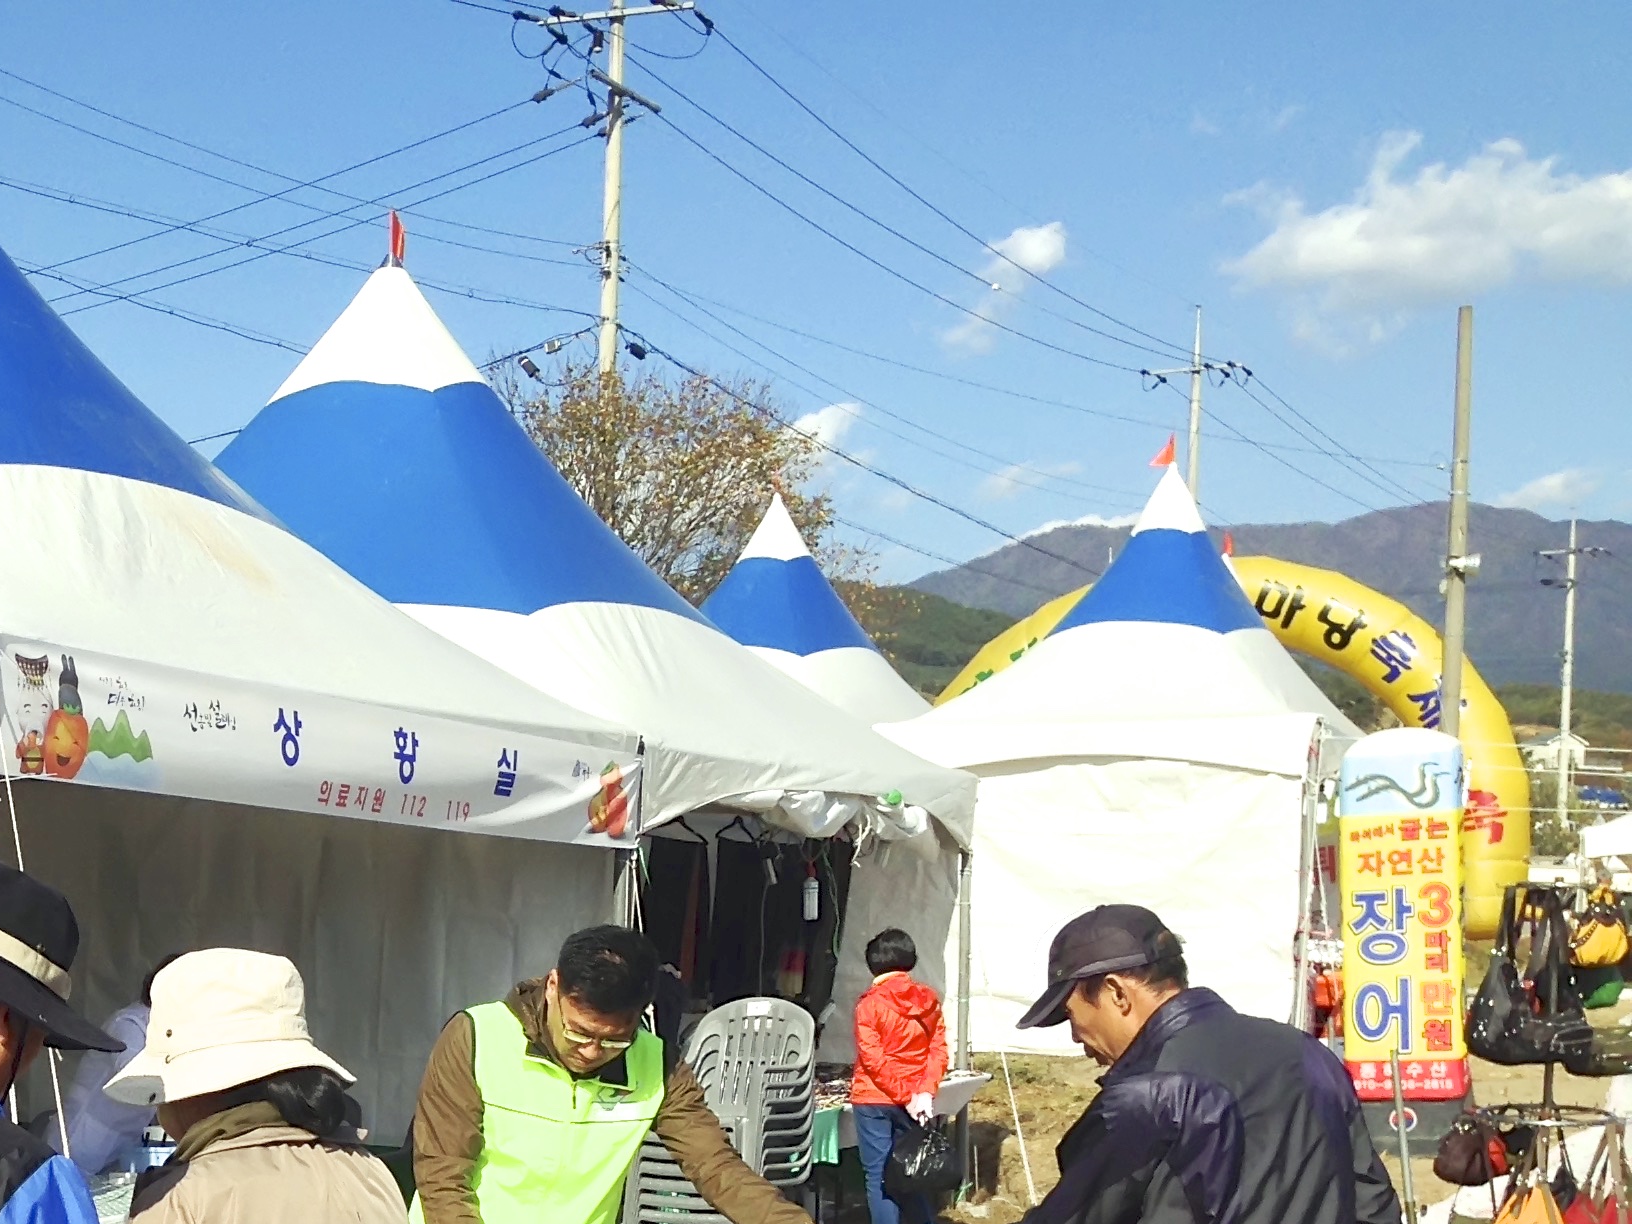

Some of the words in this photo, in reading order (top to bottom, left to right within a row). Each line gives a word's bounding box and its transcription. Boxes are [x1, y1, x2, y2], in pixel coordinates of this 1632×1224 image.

[317, 780, 386, 814] 의료지원
[400, 793, 428, 817] 112
[446, 800, 470, 822] 119
[1357, 847, 1445, 877] 자연산
[1348, 886, 1414, 1055] 장어
